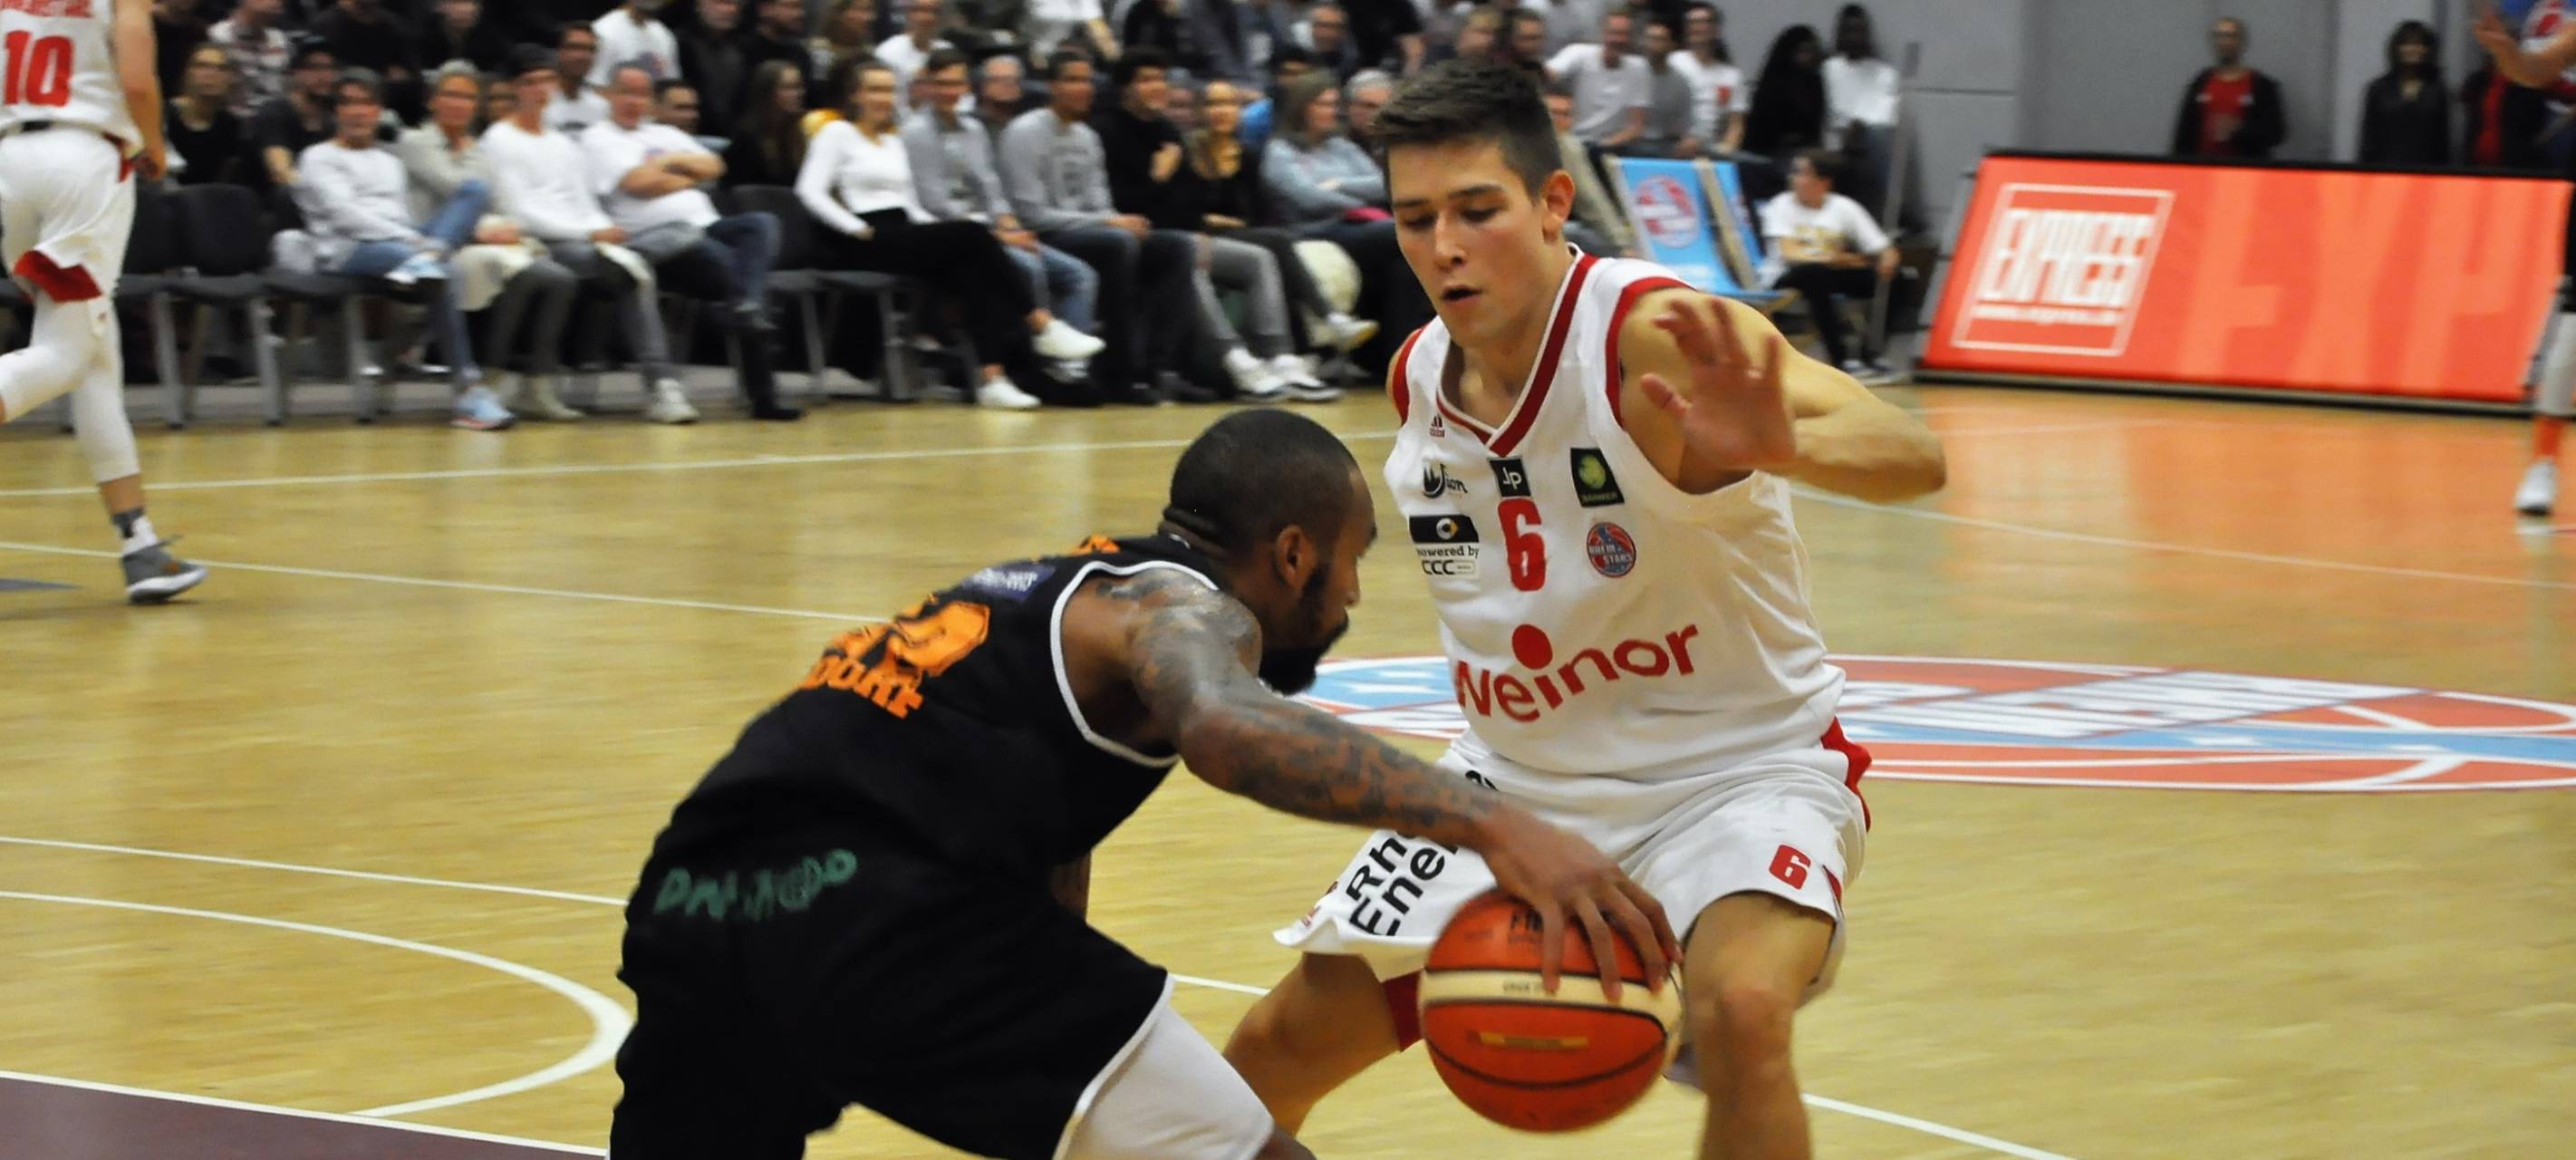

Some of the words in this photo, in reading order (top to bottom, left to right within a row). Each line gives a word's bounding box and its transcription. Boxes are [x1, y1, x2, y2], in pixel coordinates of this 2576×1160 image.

[4, 30, 73, 108] 10
[2179, 170, 2564, 399] EXP
[1421, 559, 1455, 575] CCC
[1468, 546, 1480, 559] by
[1497, 498, 1547, 592] 6
[1346, 829, 1415, 902] Rh
[1768, 843, 1812, 890] 6
